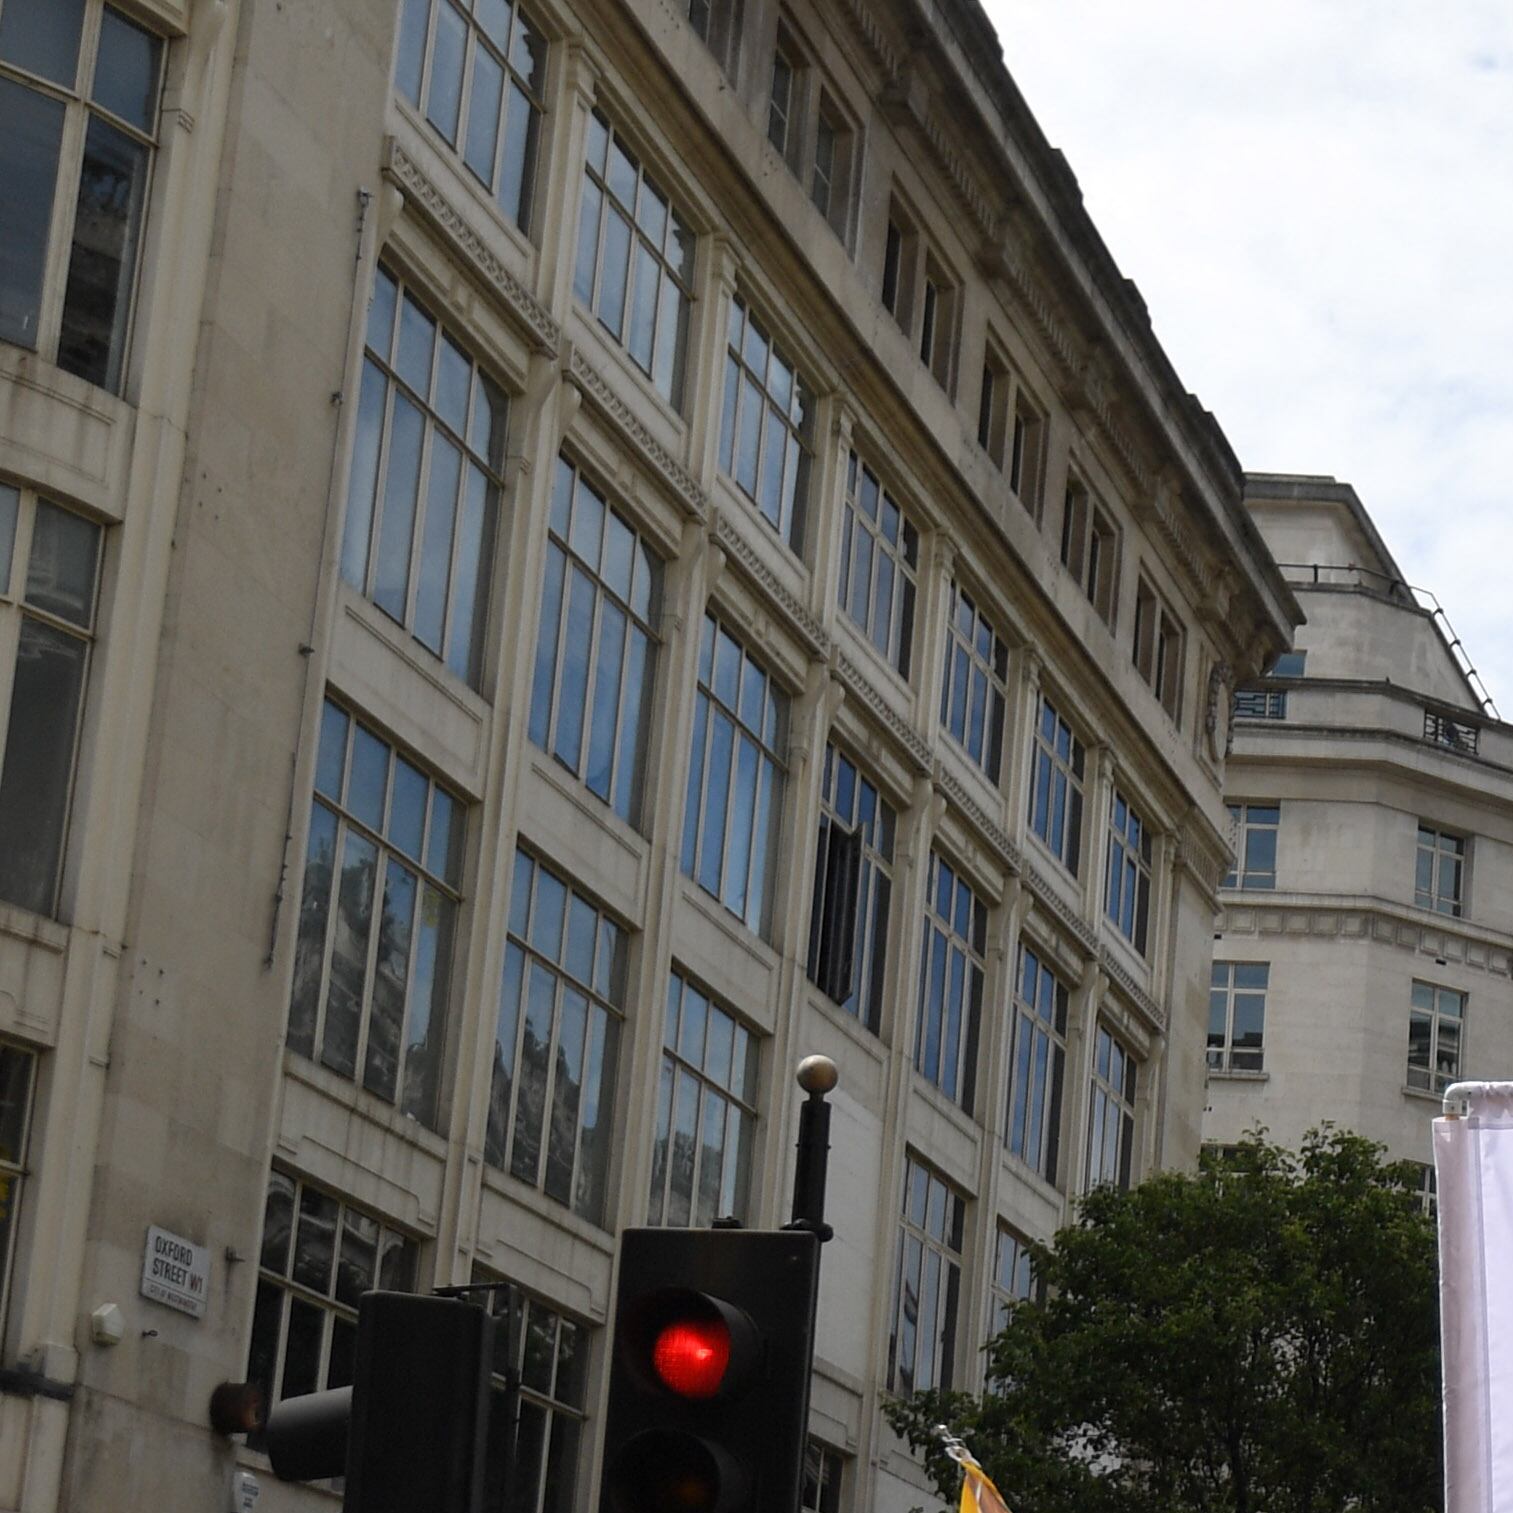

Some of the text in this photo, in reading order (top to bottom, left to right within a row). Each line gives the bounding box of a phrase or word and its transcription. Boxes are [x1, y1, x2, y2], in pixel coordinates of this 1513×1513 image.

[155, 1236, 193, 1267] OXFORD
[152, 1257, 203, 1294] STREET W1
